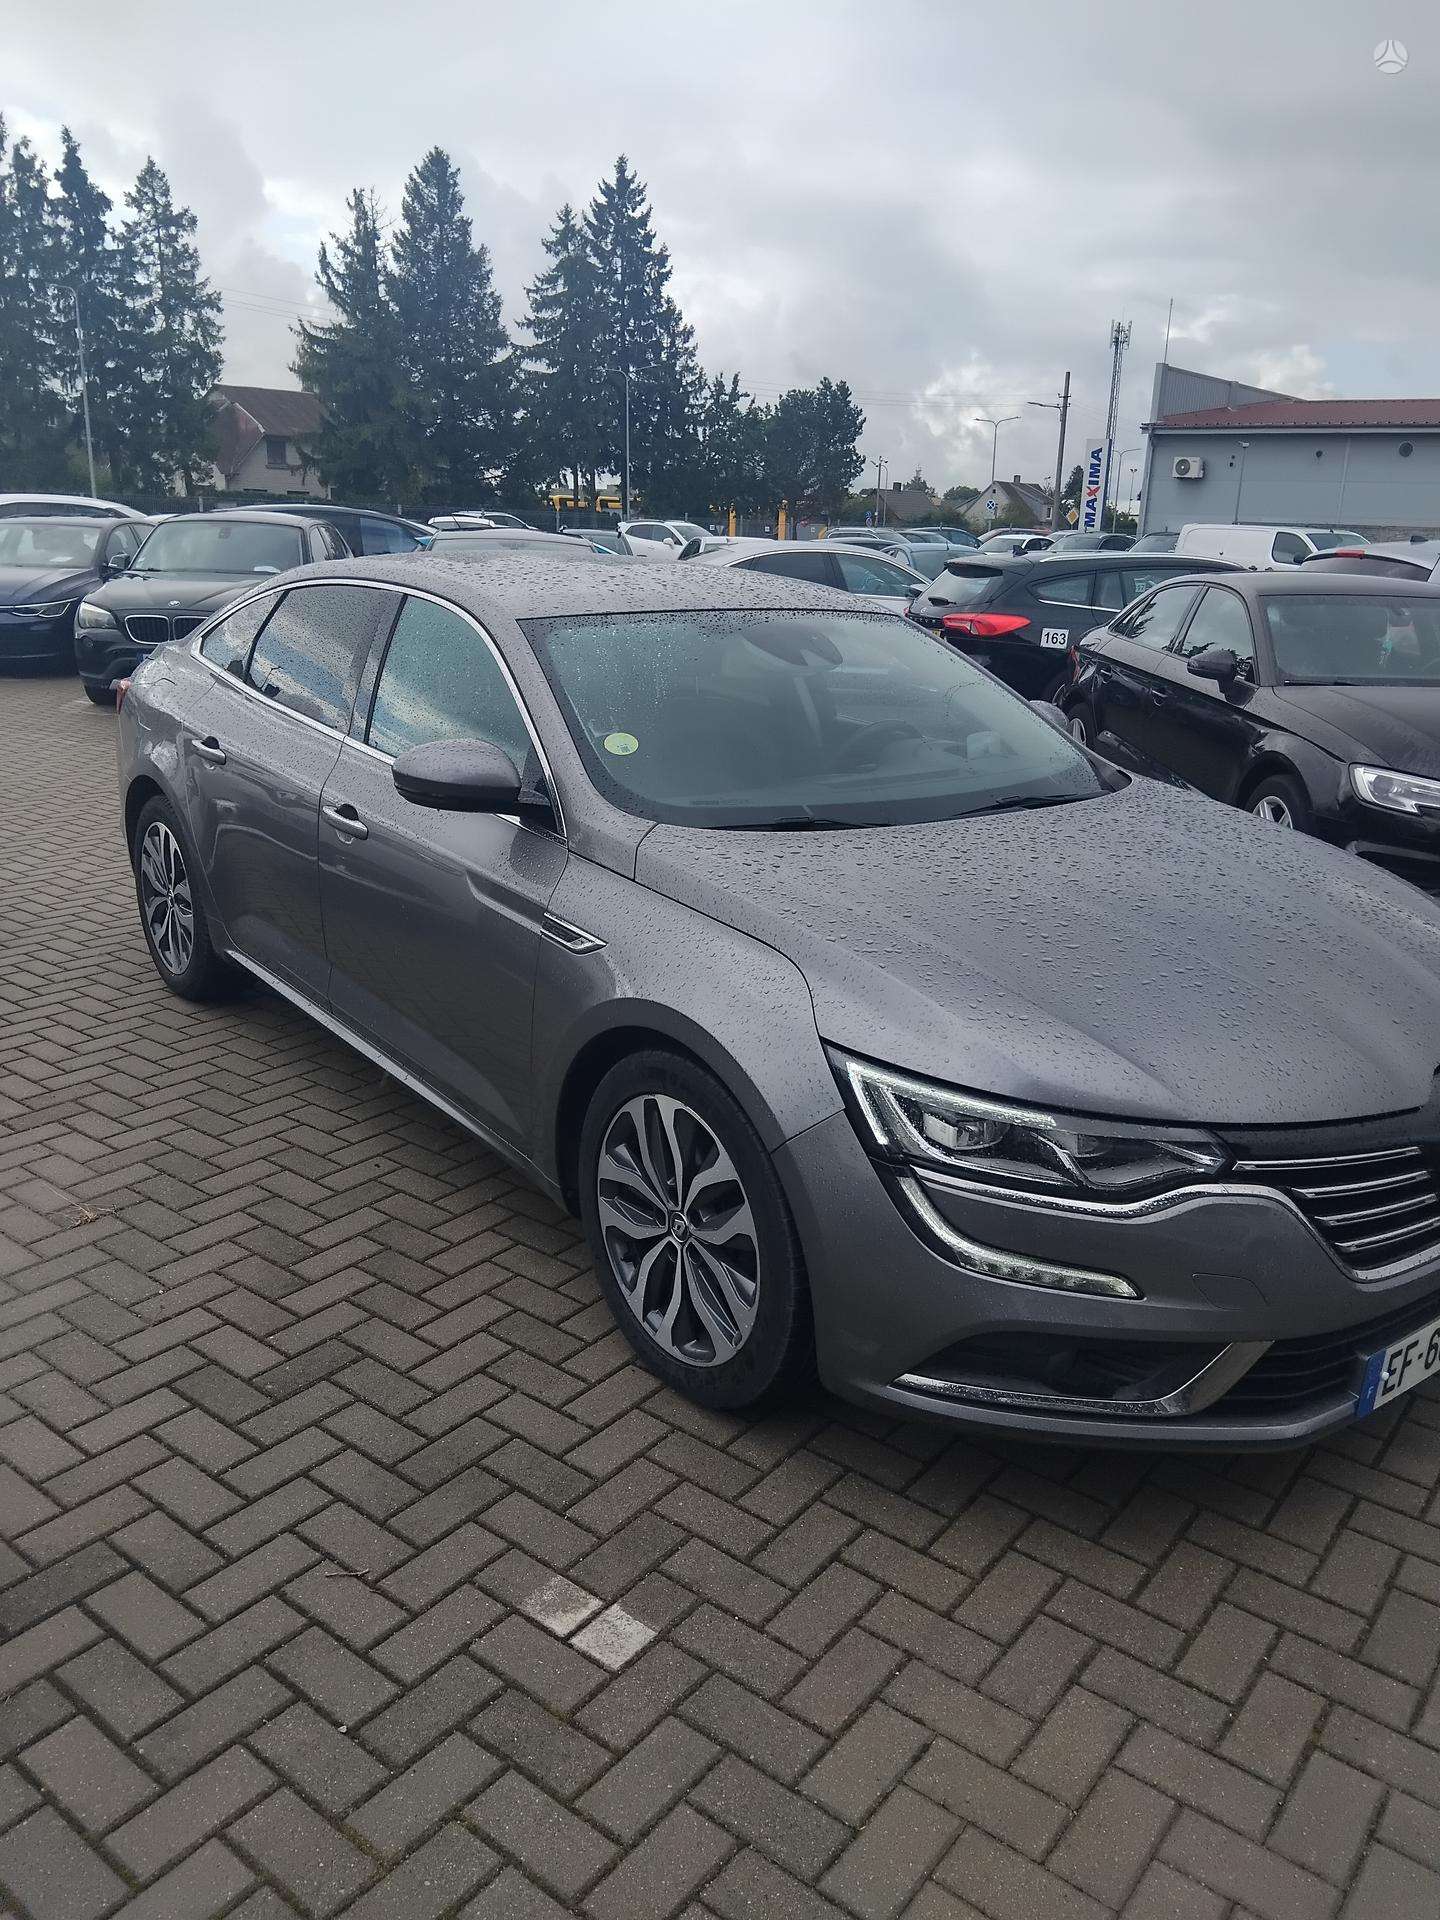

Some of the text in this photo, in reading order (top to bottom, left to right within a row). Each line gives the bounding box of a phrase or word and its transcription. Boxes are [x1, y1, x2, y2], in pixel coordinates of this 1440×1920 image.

[1084, 447, 1103, 528] MAXIMA
[1044, 632, 1066, 645] 163
[1382, 1327, 1440, 1397] EF-6
